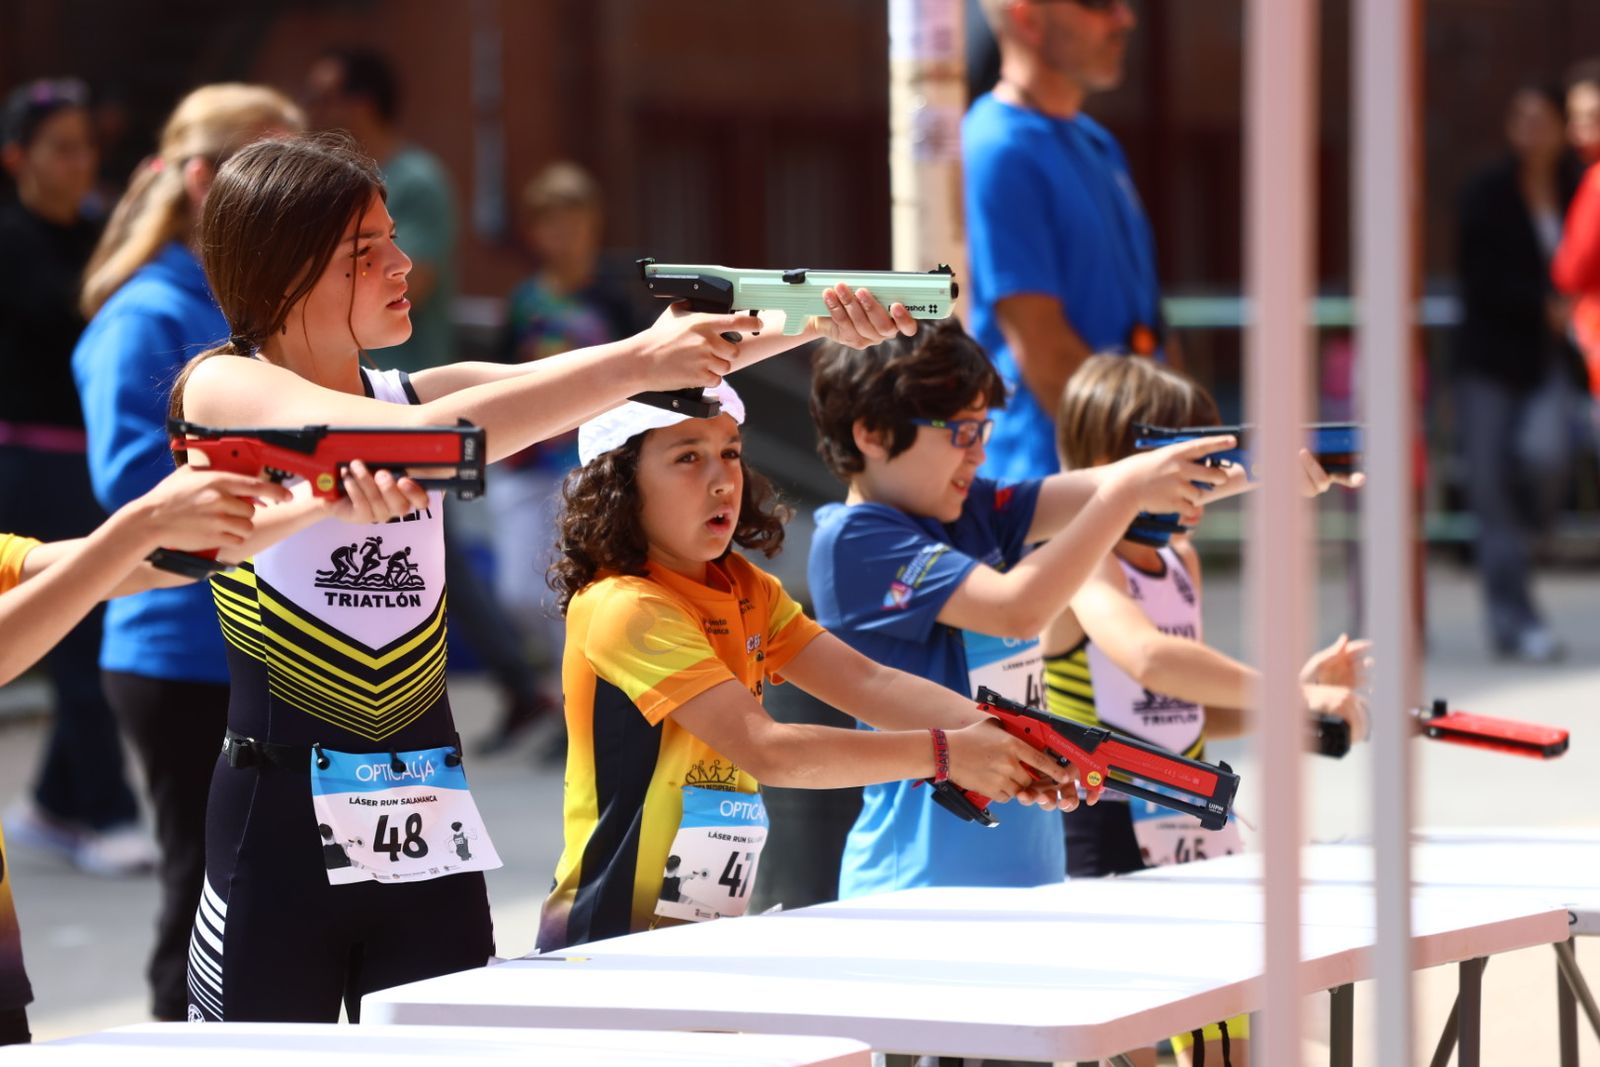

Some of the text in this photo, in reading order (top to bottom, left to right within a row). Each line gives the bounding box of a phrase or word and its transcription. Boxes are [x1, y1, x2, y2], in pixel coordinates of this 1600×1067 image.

[324, 592, 421, 608] TRIATLÓN
[349, 796, 378, 807] LÁSER
[400, 795, 438, 806] SALAMANCA
[372, 812, 429, 862] 48
[732, 835, 747, 843] RUN
[718, 850, 757, 898] 47
